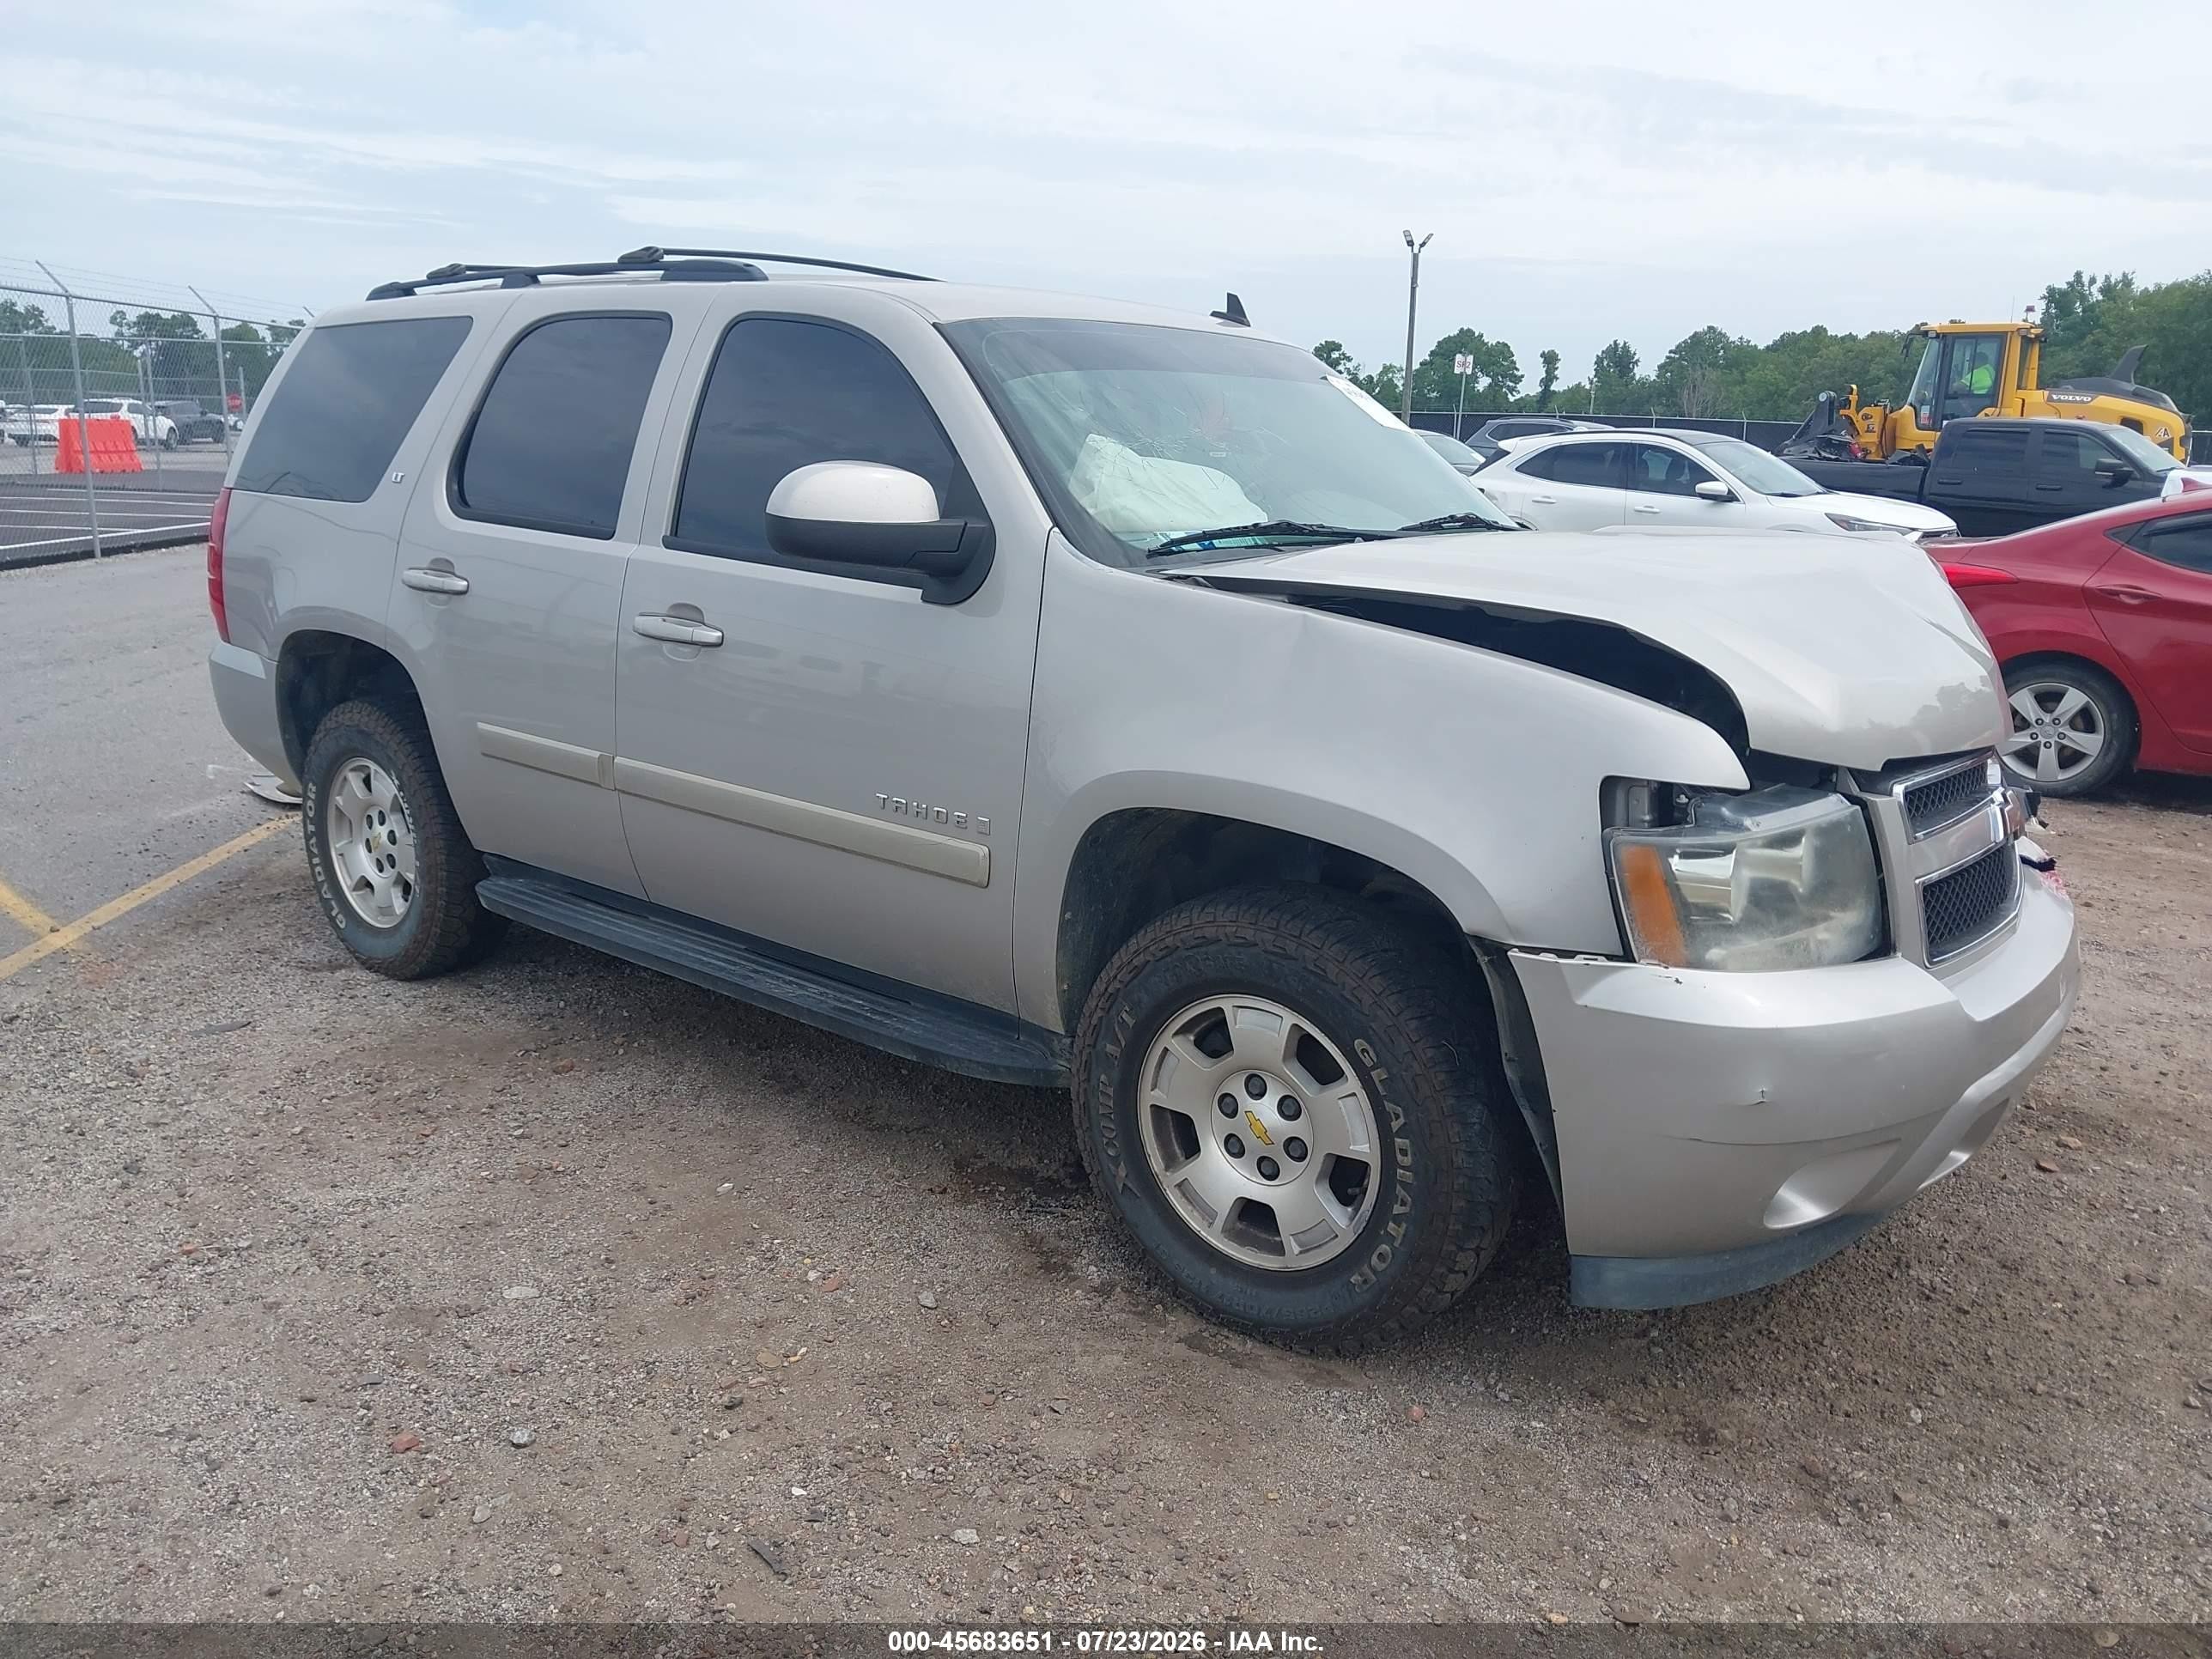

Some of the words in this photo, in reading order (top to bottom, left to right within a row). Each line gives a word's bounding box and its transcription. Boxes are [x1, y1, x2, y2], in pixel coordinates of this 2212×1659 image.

[2051, 393, 2092, 402] VOLVO
[392, 472, 404, 483] LT
[875, 793, 968, 830] TAHOE
[306, 782, 346, 928] GLADIATOR
[1105, 1003, 1136, 1061] A/T
[1099, 1073, 1119, 1157] COMP
[1349, 1039, 1415, 1292] GLADIATOR
